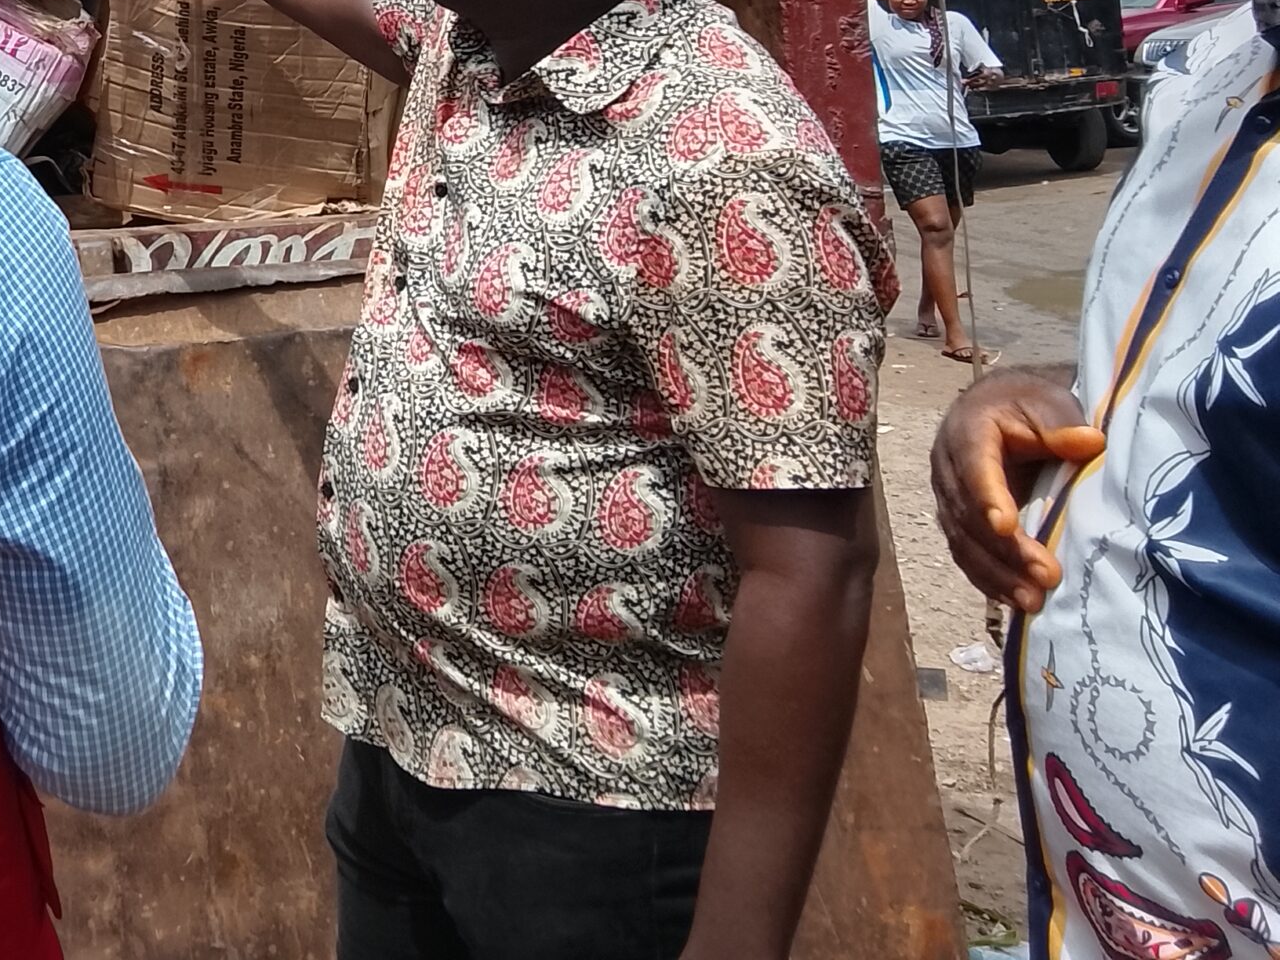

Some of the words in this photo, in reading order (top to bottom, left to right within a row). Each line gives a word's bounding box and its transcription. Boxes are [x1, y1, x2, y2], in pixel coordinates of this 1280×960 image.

[202, 6, 221, 44] Awka,
[202, 46, 220, 88] Estate,
[229, 26, 249, 72] Nigeria.
[200, 91, 219, 139] Housing
[229, 75, 249, 112] State,
[226, 113, 243, 164] Anambra
